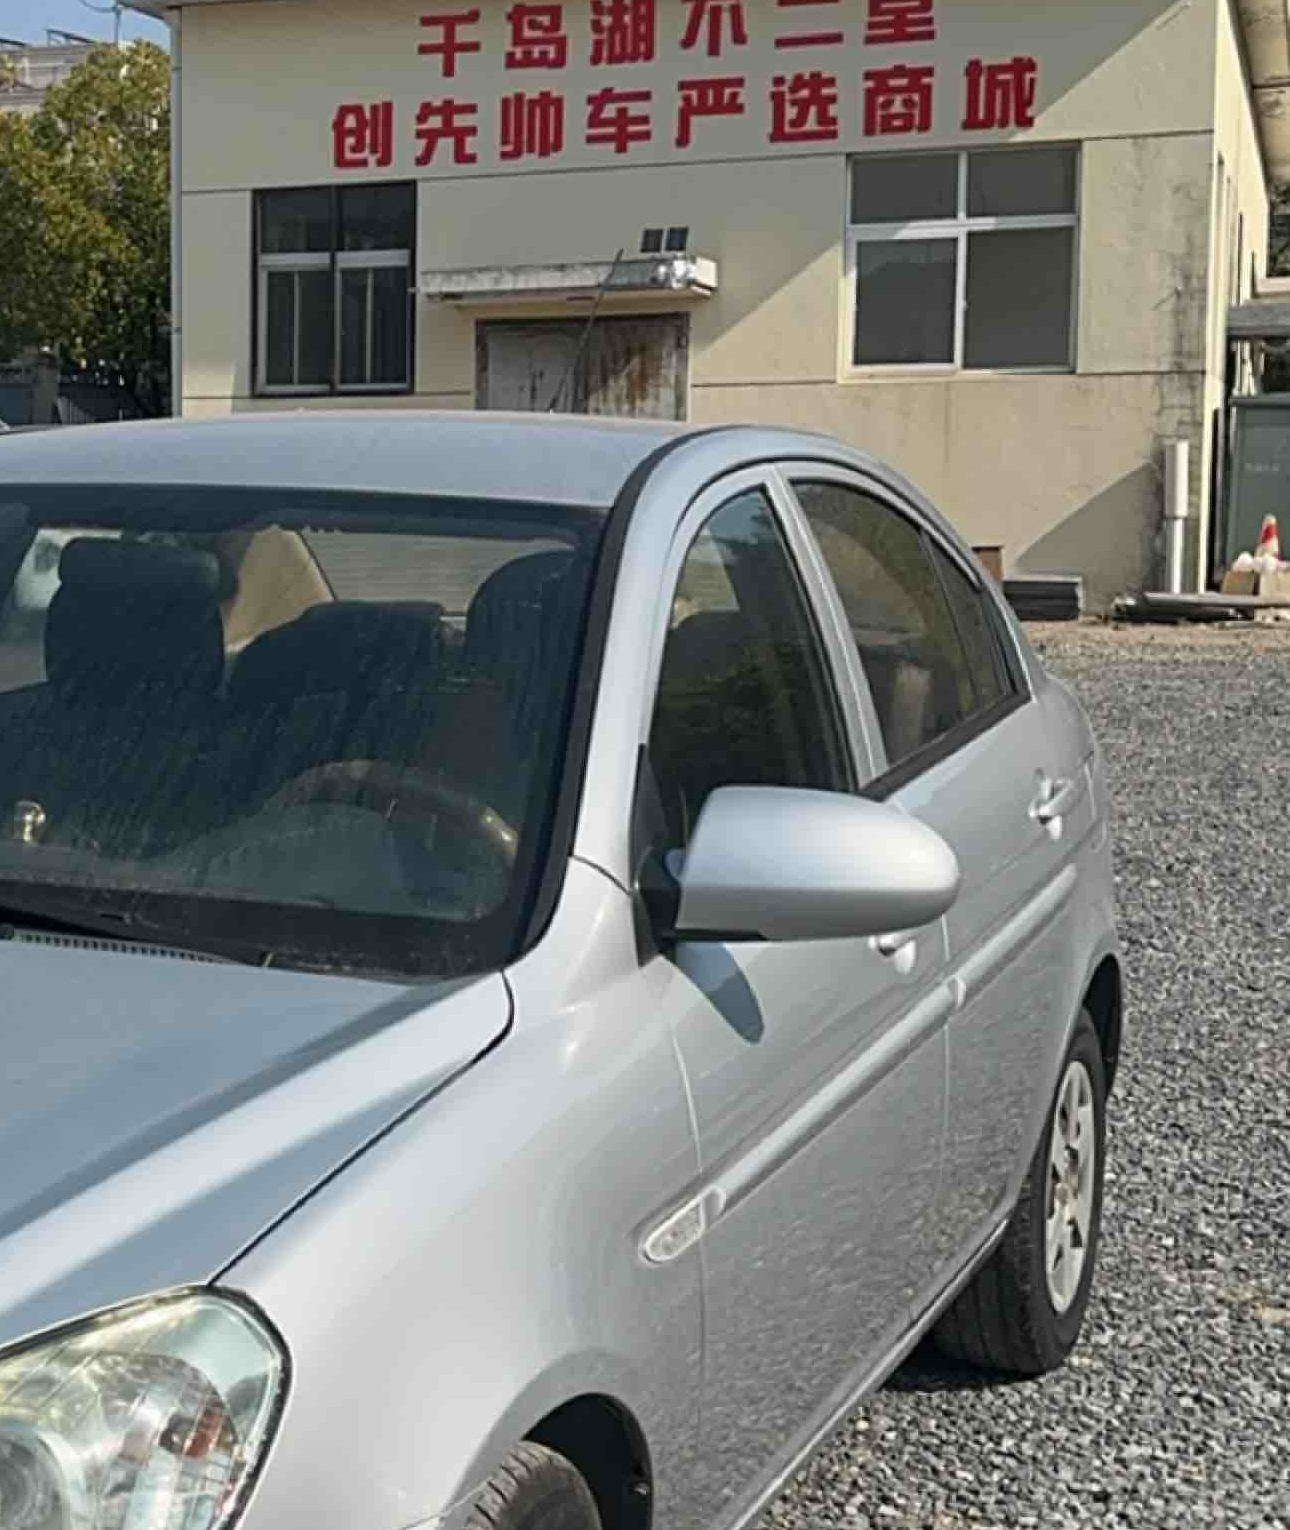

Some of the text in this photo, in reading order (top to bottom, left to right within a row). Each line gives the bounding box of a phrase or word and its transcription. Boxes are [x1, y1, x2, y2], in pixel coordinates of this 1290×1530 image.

[331, 56, 1039, 169] 创先帅车严选商城
